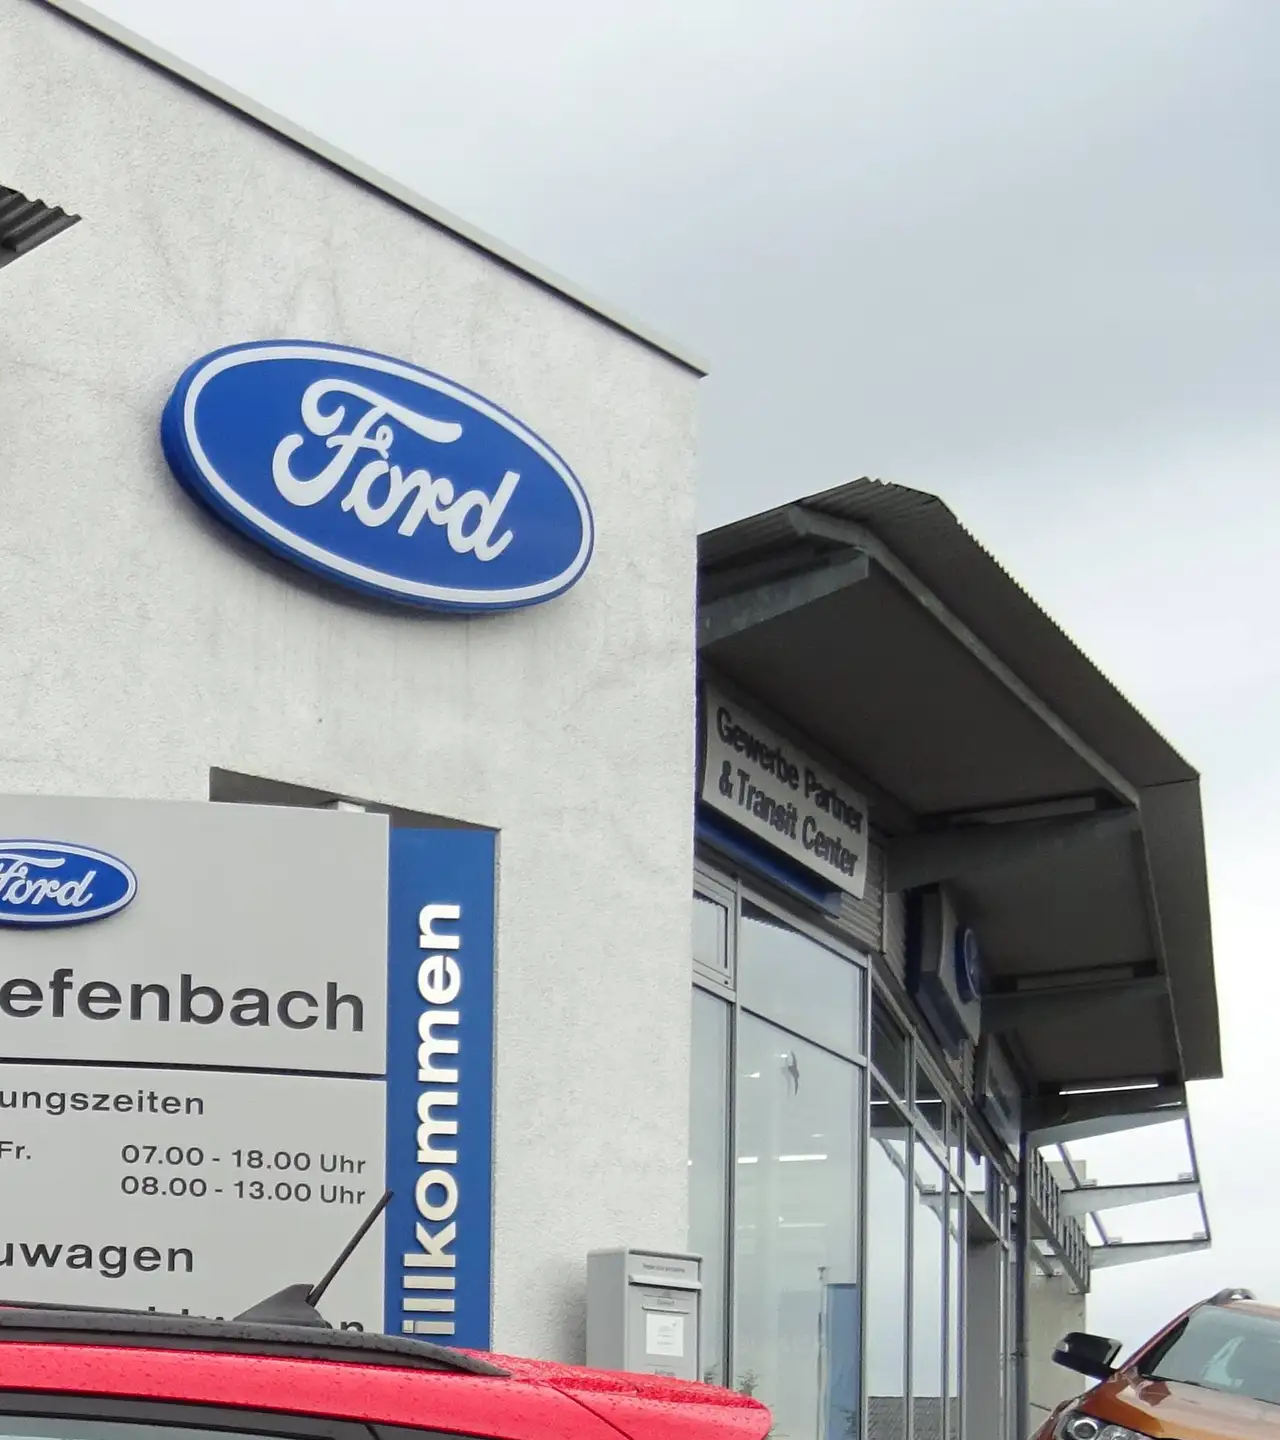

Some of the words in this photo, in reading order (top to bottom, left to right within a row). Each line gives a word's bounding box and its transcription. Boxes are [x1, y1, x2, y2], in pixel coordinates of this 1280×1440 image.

[272, 379, 521, 562] Ford
[716, 706, 800, 791] Gewerbe
[804, 767, 863, 834] Partner
[718, 760, 734, 799] &
[737, 768, 798, 840] Transit
[802, 815, 859, 877] Center
[121, 1144, 204, 1167] 07.00
[231, 1149, 311, 1172] 18.00
[320, 1153, 366, 1174] Uhr
[403, 903, 462, 1334] illkommen
[120, 1175, 207, 1198] 08.00
[233, 1180, 312, 1203] 13.00
[320, 1184, 366, 1205] Uhr
